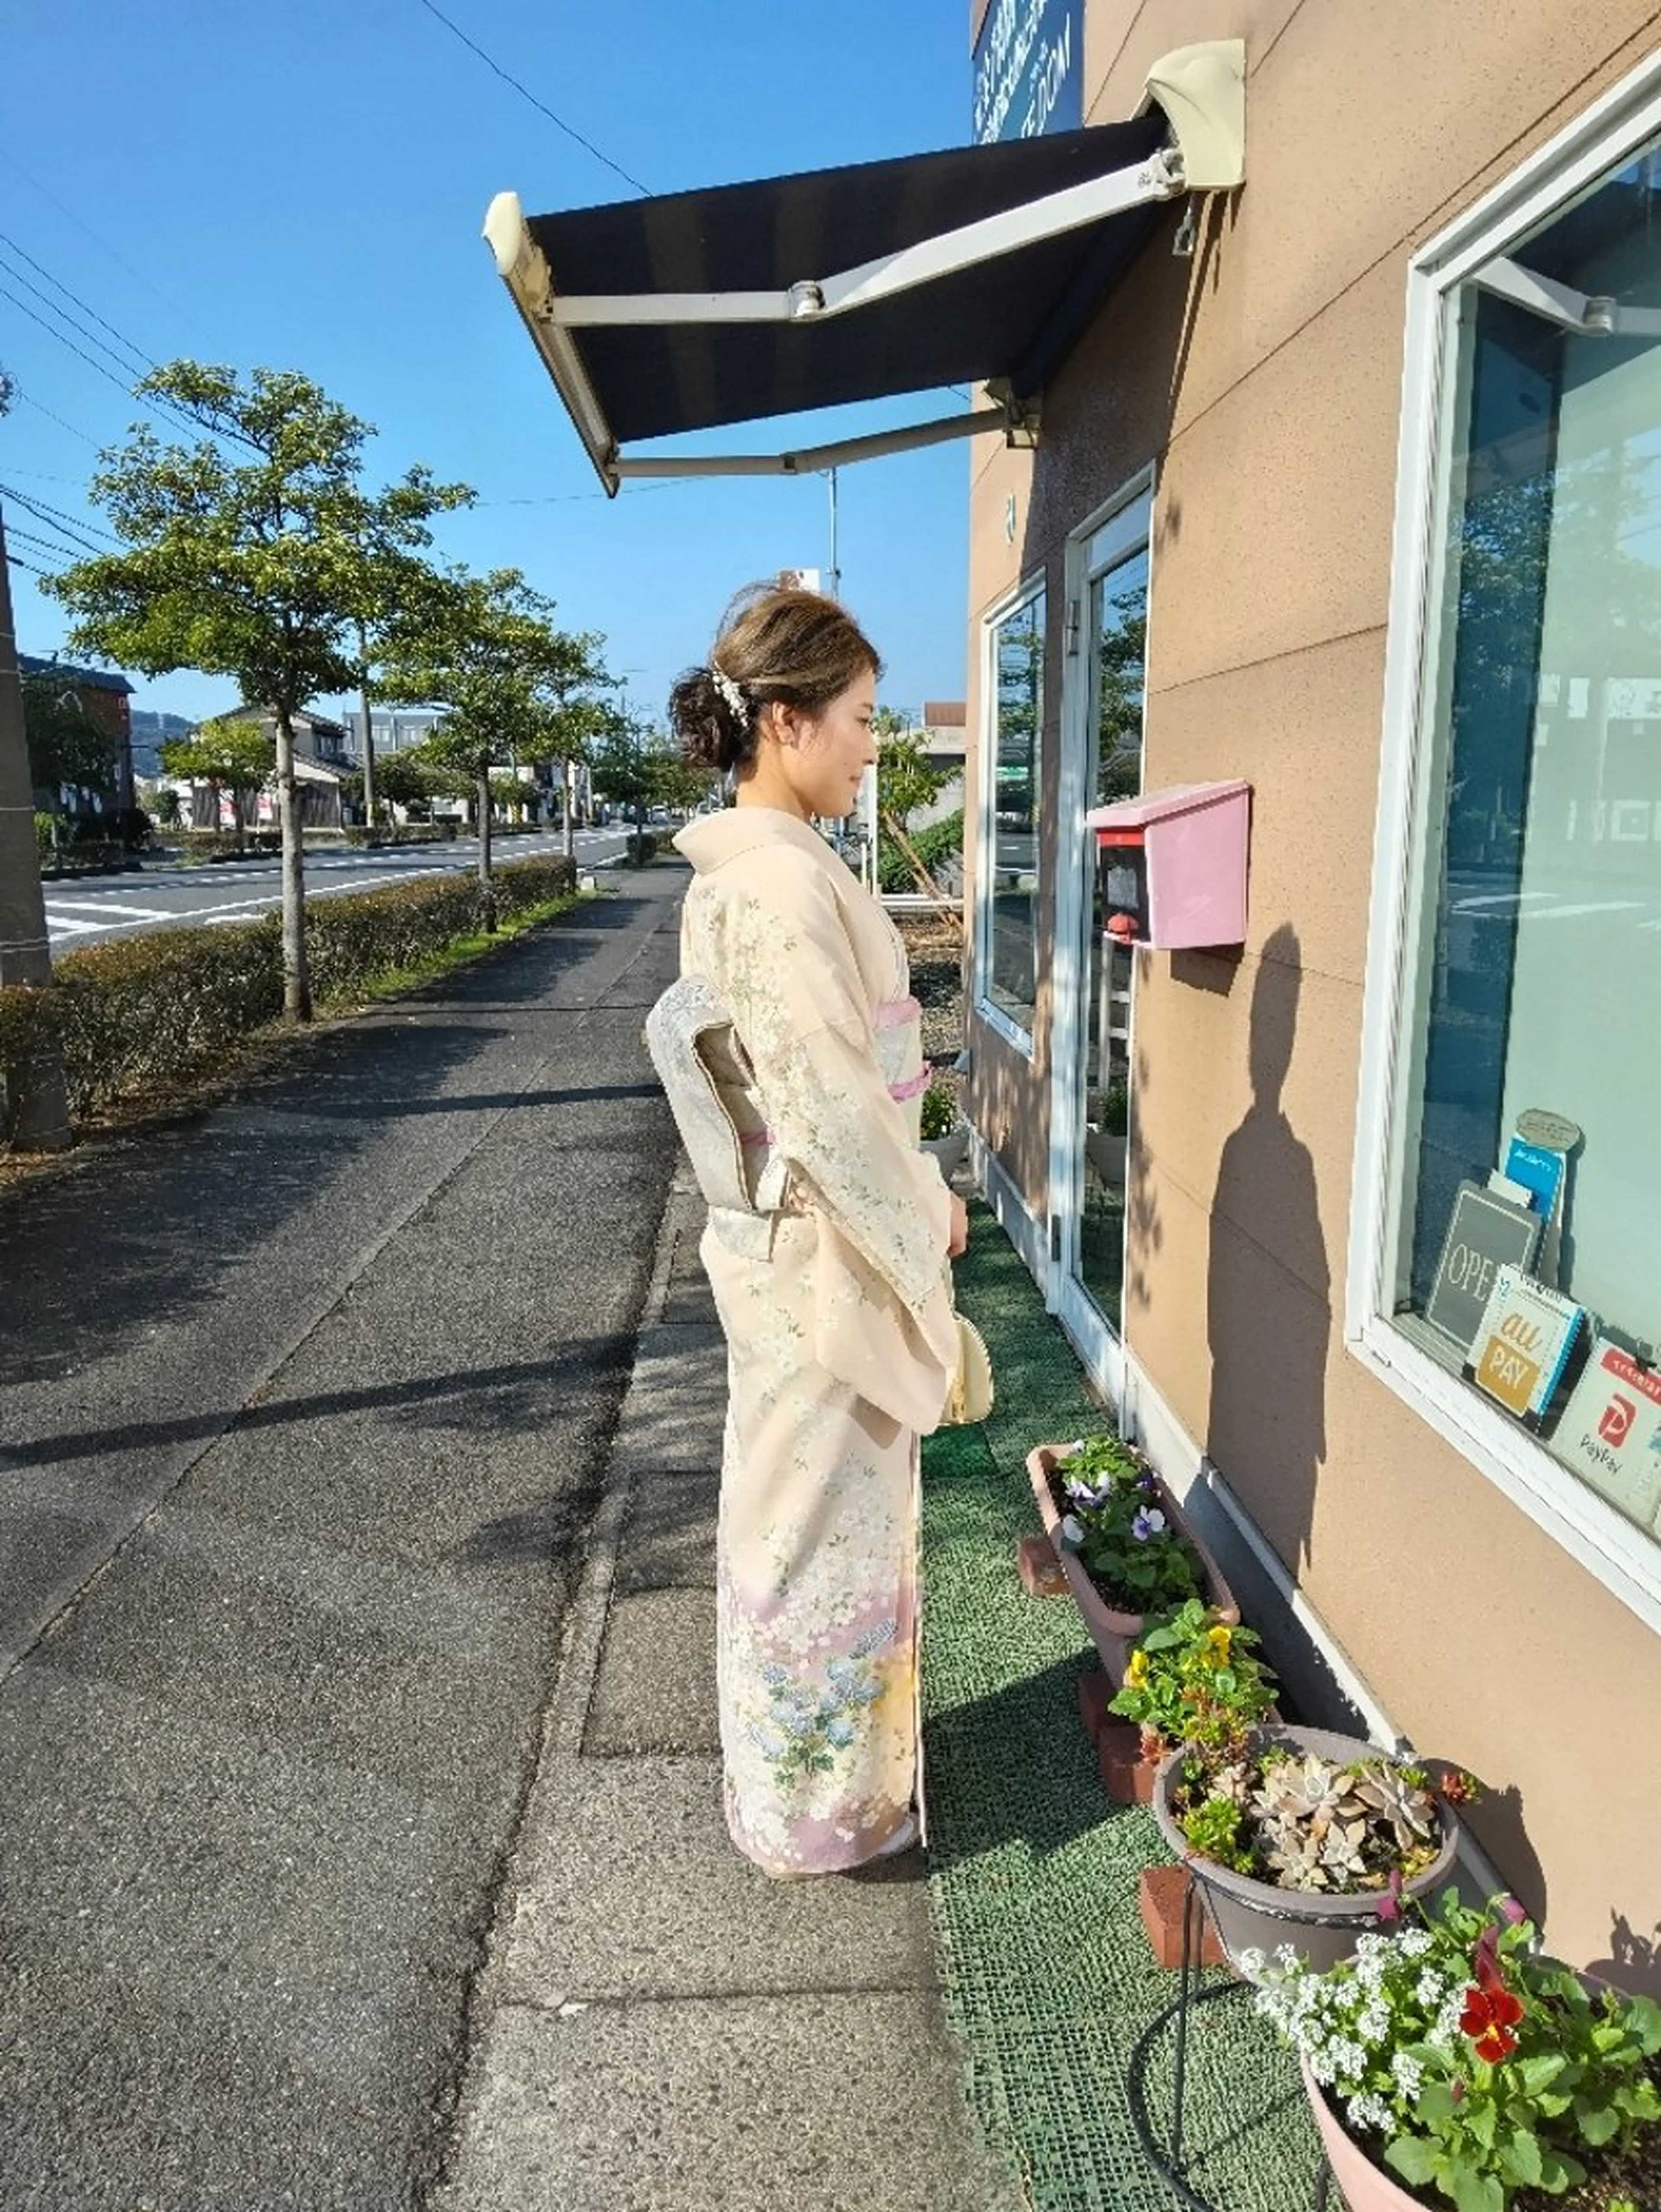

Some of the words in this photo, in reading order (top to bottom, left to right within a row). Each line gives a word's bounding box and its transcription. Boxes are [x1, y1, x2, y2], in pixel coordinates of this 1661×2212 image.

[1449, 1244, 1500, 1301] OPE
[1501, 1312, 1542, 1351] au
[1490, 1344, 1529, 1389] PAY
[1580, 1433, 1622, 1475] PayPay
